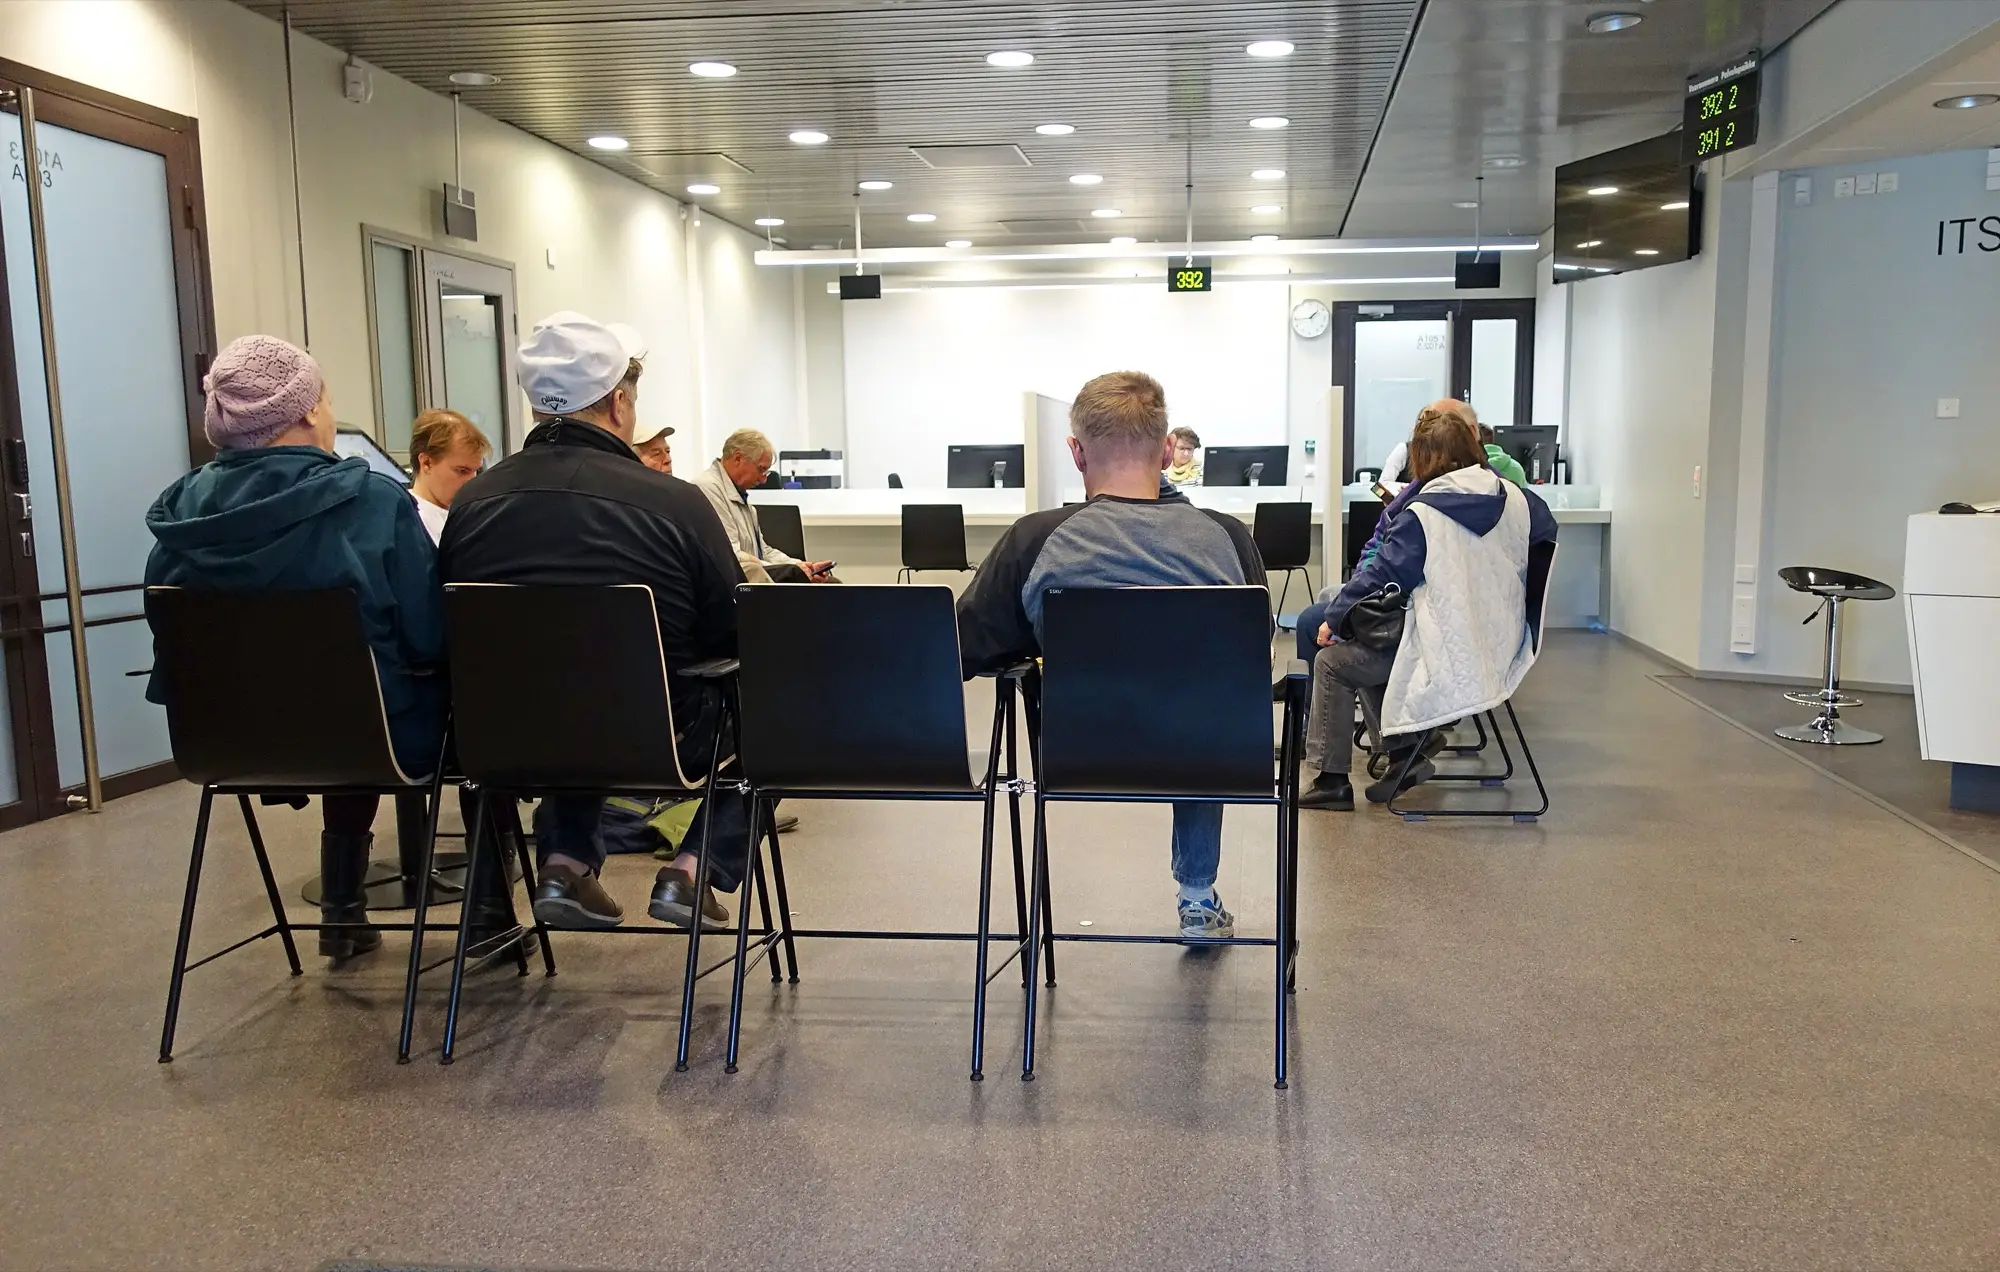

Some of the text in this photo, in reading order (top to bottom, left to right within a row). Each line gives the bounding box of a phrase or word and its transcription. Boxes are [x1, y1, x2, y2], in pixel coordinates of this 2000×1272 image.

[1700, 85, 1738, 120] 392 2
[1697, 121, 1735, 156] 391 2
[1937, 215, 2000, 256] ITS
[1185, 255, 1193, 268] 2
[1176, 271, 1203, 289] 392
